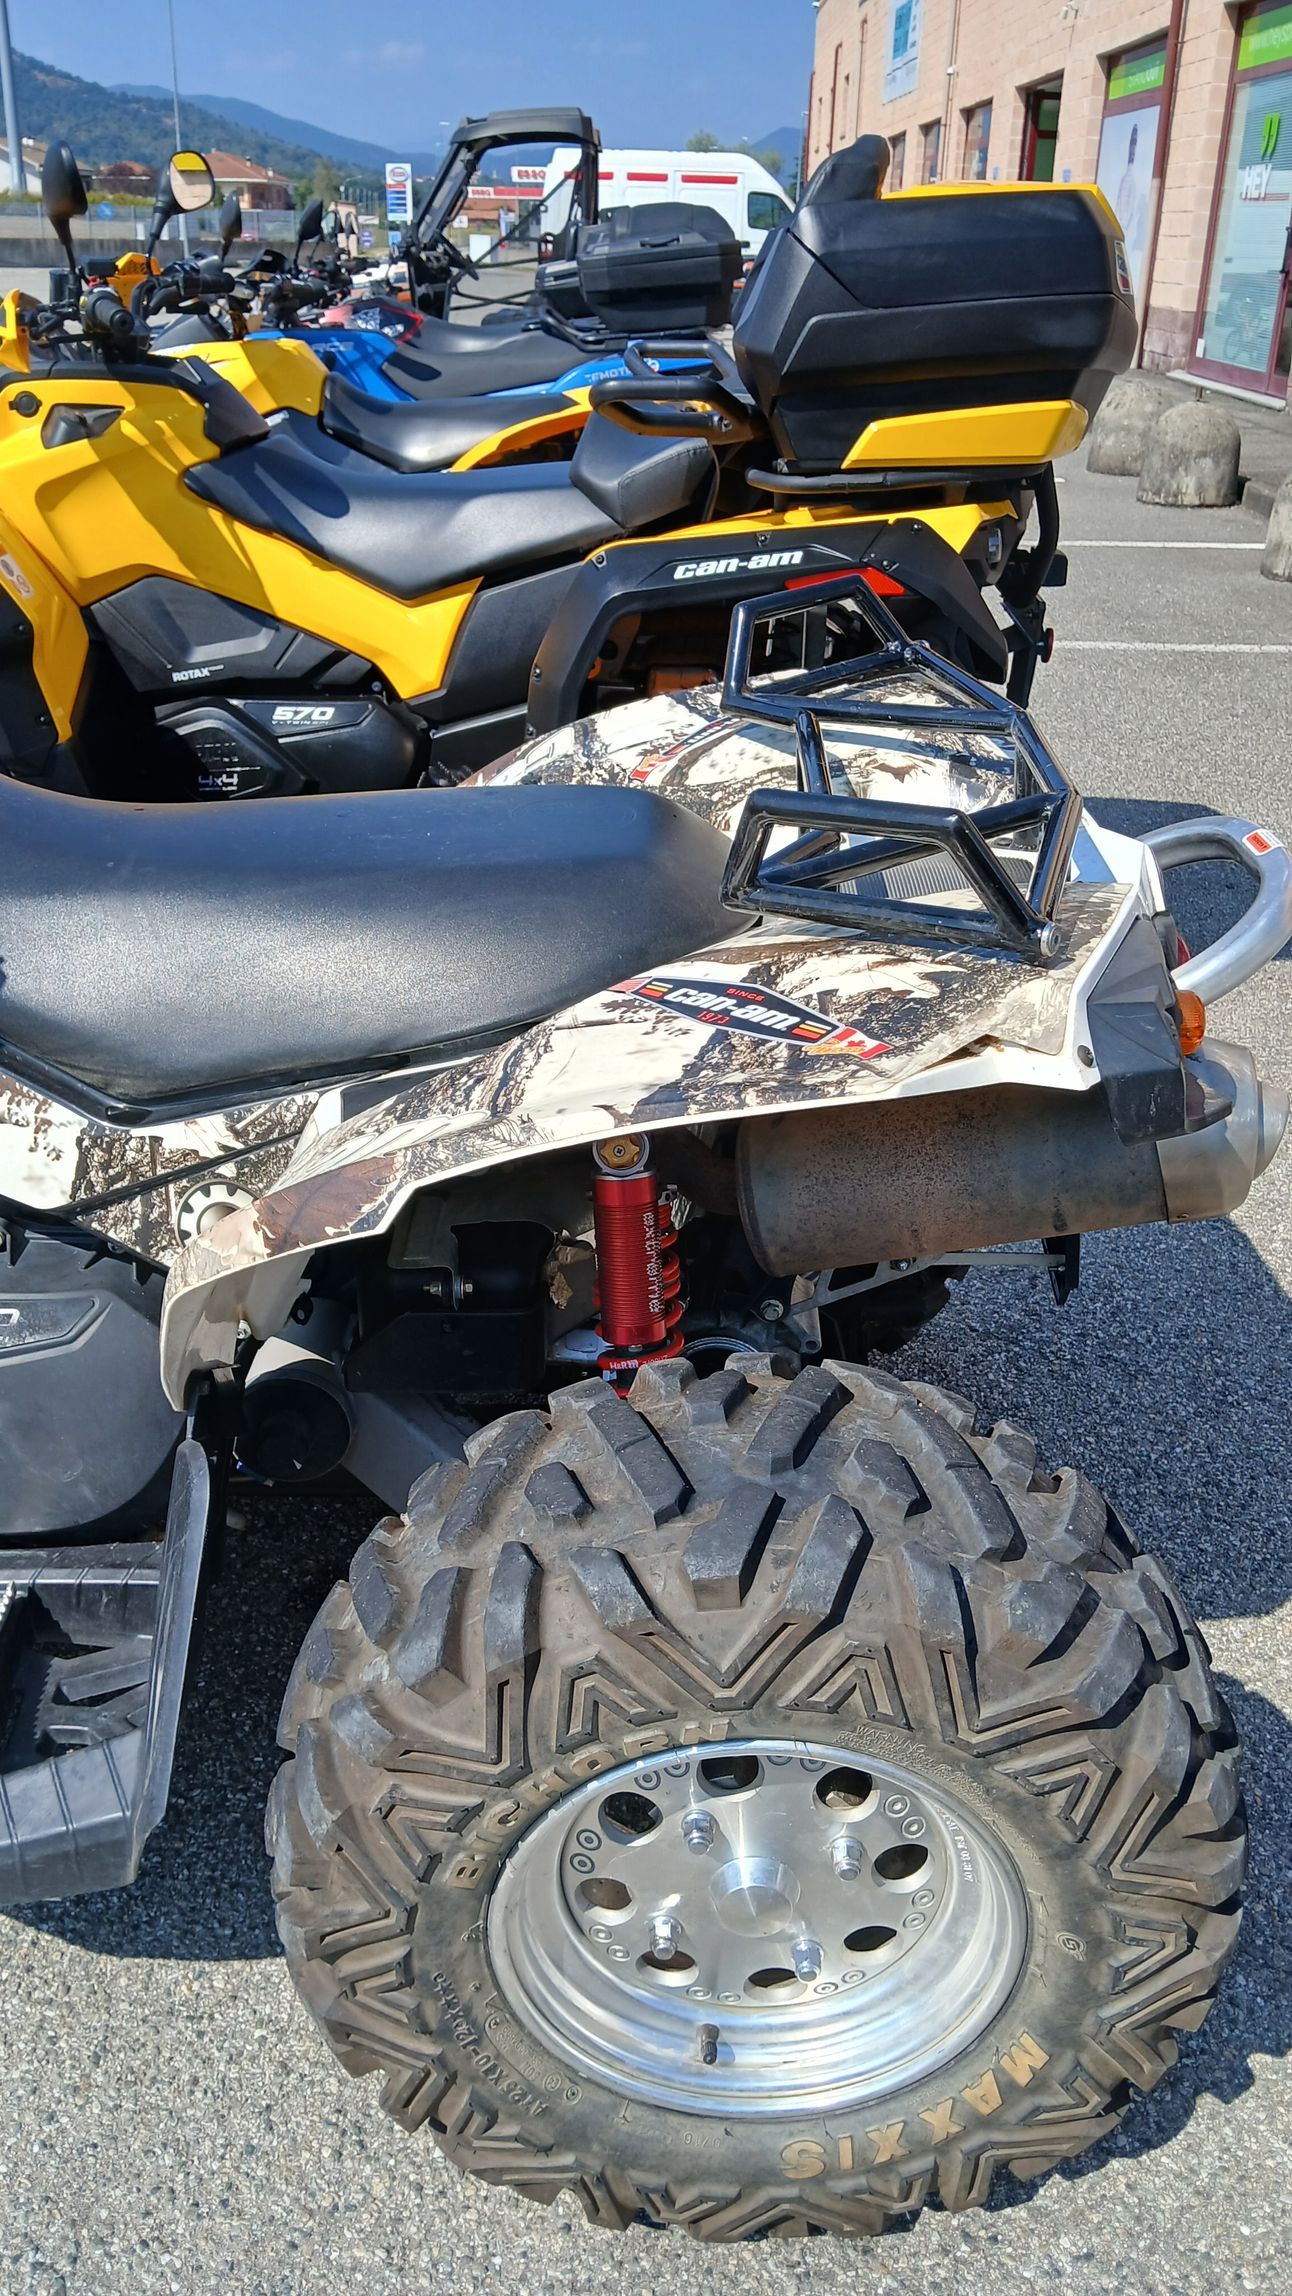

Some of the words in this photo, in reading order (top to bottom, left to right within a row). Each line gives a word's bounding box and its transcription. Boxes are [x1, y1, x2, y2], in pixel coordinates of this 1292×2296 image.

[1242, 163, 1272, 200] HEY
[673, 551, 803, 580] can-am
[172, 668, 210, 682] ROTAX
[272, 706, 336, 720] 570
[726, 987, 765, 1002] SINCE
[663, 987, 801, 1031] can-am
[697, 1010, 730, 1025] 1973
[857, 1725, 927, 1753] WARNING
[780, 2031, 1050, 2180] MAXXIS
